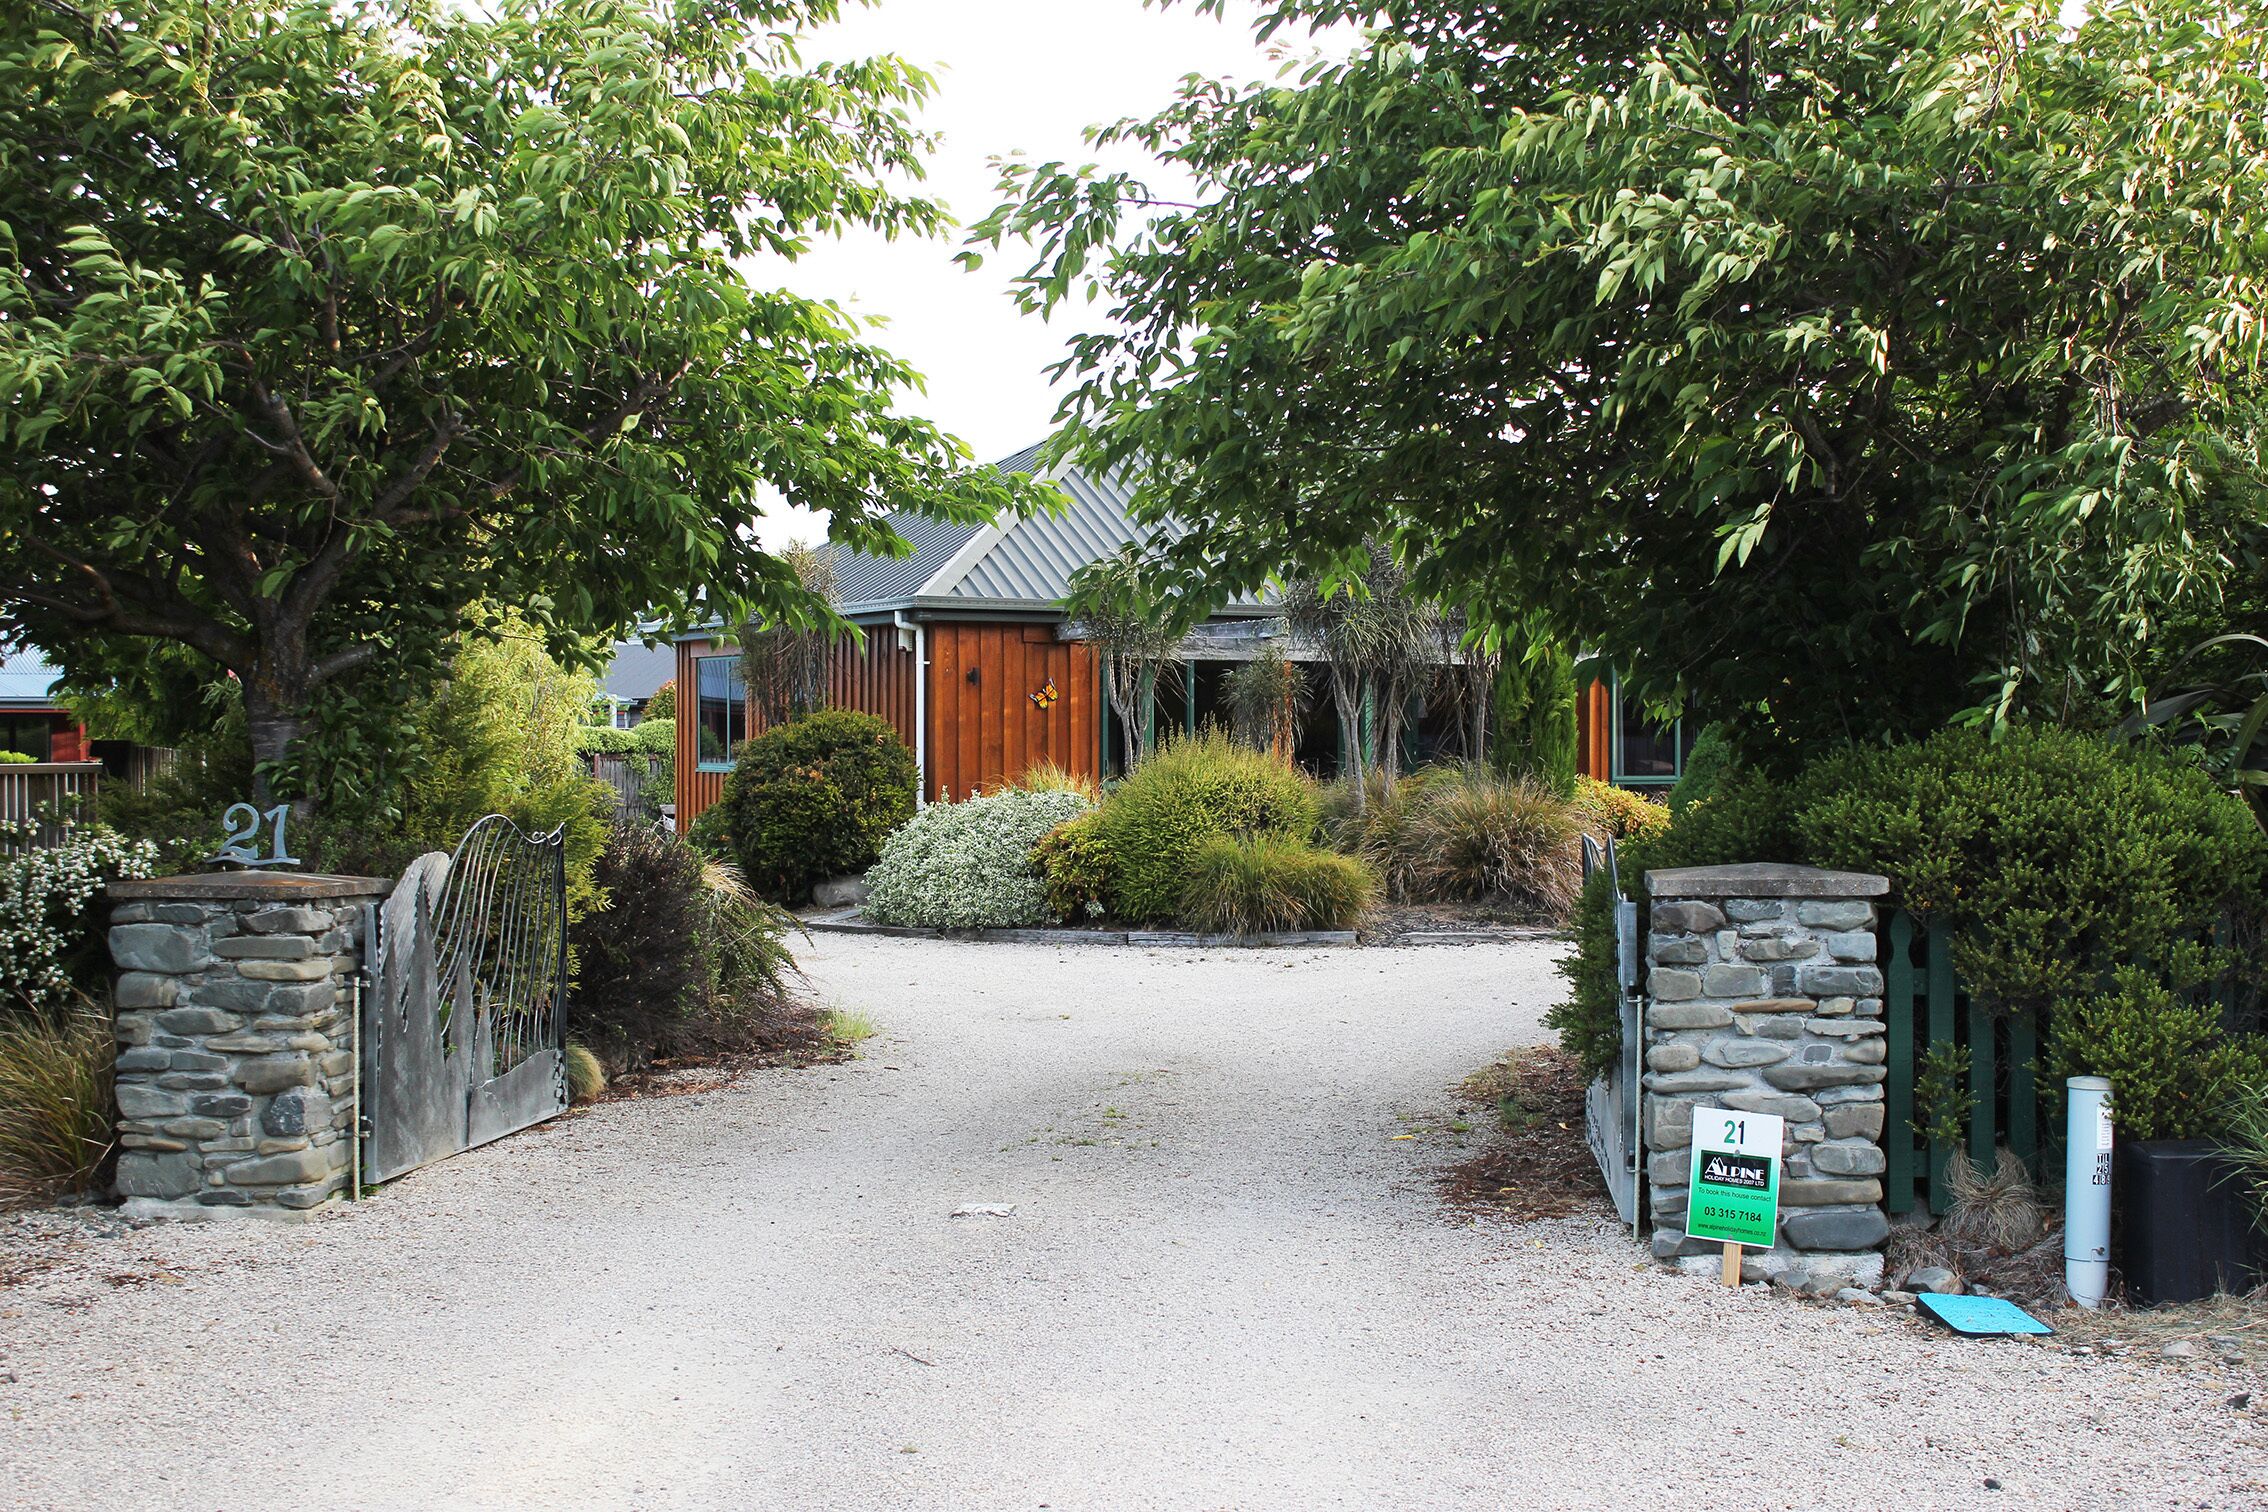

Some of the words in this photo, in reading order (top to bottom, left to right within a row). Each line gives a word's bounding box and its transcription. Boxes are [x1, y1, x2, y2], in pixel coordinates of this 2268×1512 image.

[219, 802, 290, 860] 21
[1724, 1120, 1745, 1144] 21
[2097, 1153, 2109, 1163] TL
[1705, 1157, 1764, 1181] ALPINE
[2097, 1164, 2109, 1174] 25
[1704, 1174, 1724, 1182] HOLIDAY
[1704, 1206, 1716, 1216] 03
[1718, 1208, 1736, 1219] 315
[1738, 1210, 1762, 1222] 7184
[1698, 1223, 1767, 1236] www.alpineholidayhomes.co.nz
